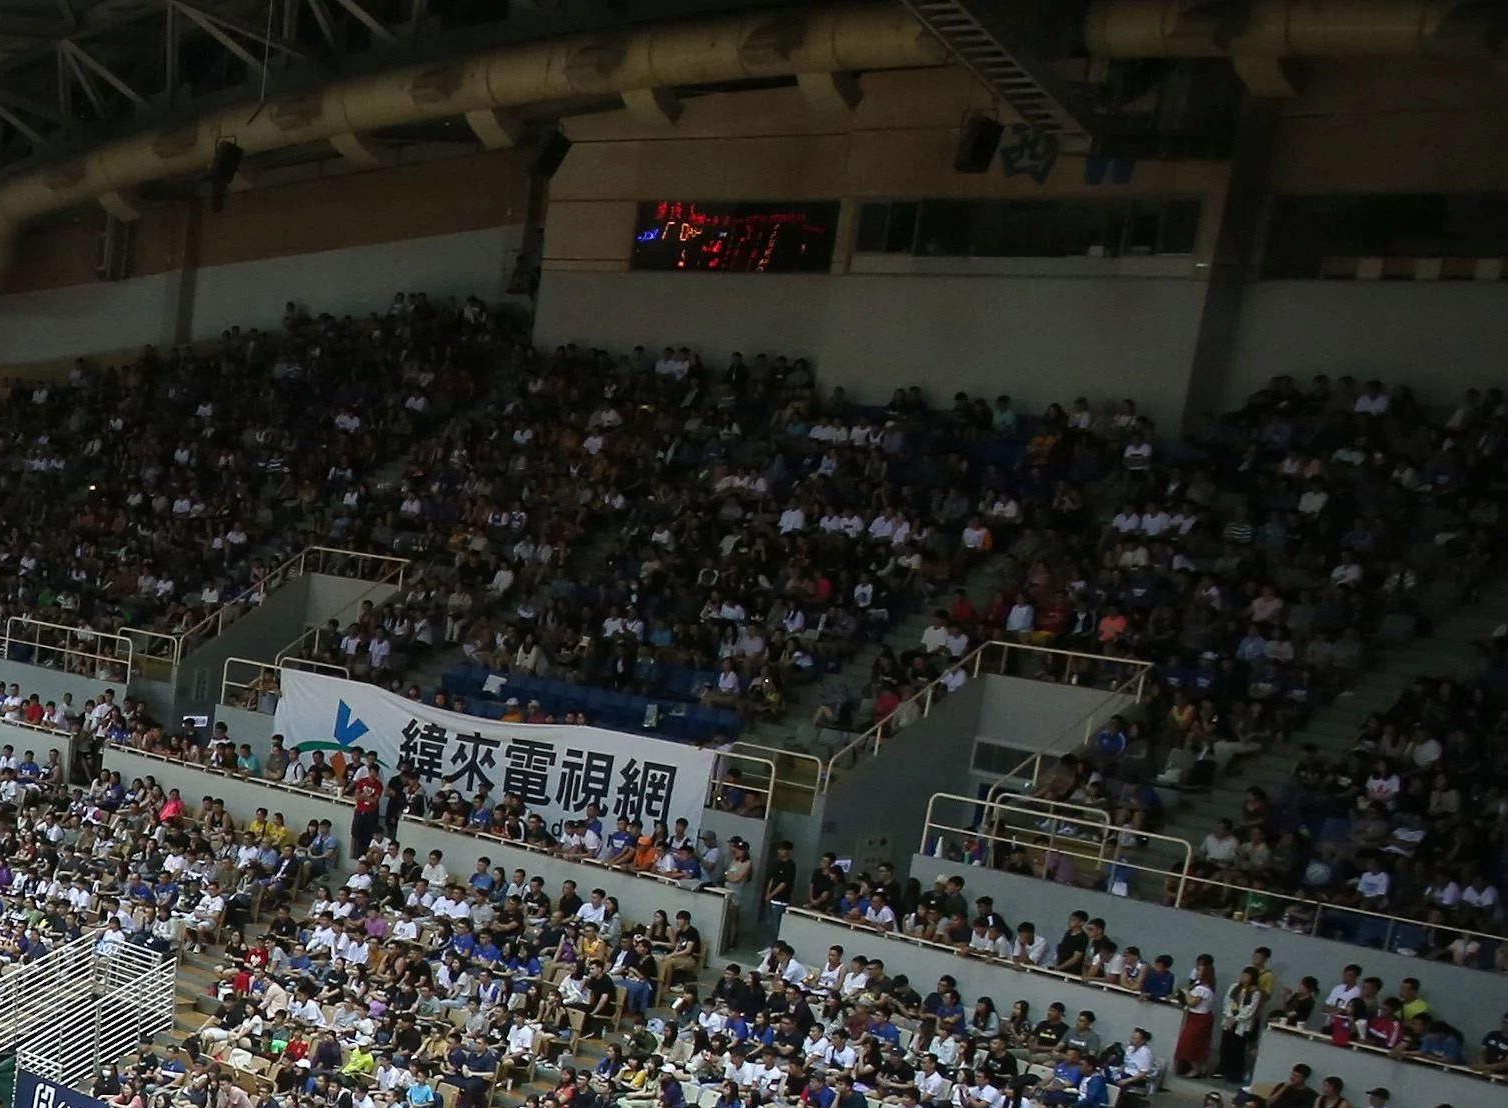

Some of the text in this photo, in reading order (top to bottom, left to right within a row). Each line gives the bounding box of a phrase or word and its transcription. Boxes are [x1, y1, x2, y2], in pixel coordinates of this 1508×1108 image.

[397, 718, 679, 827] 緯來電視網
